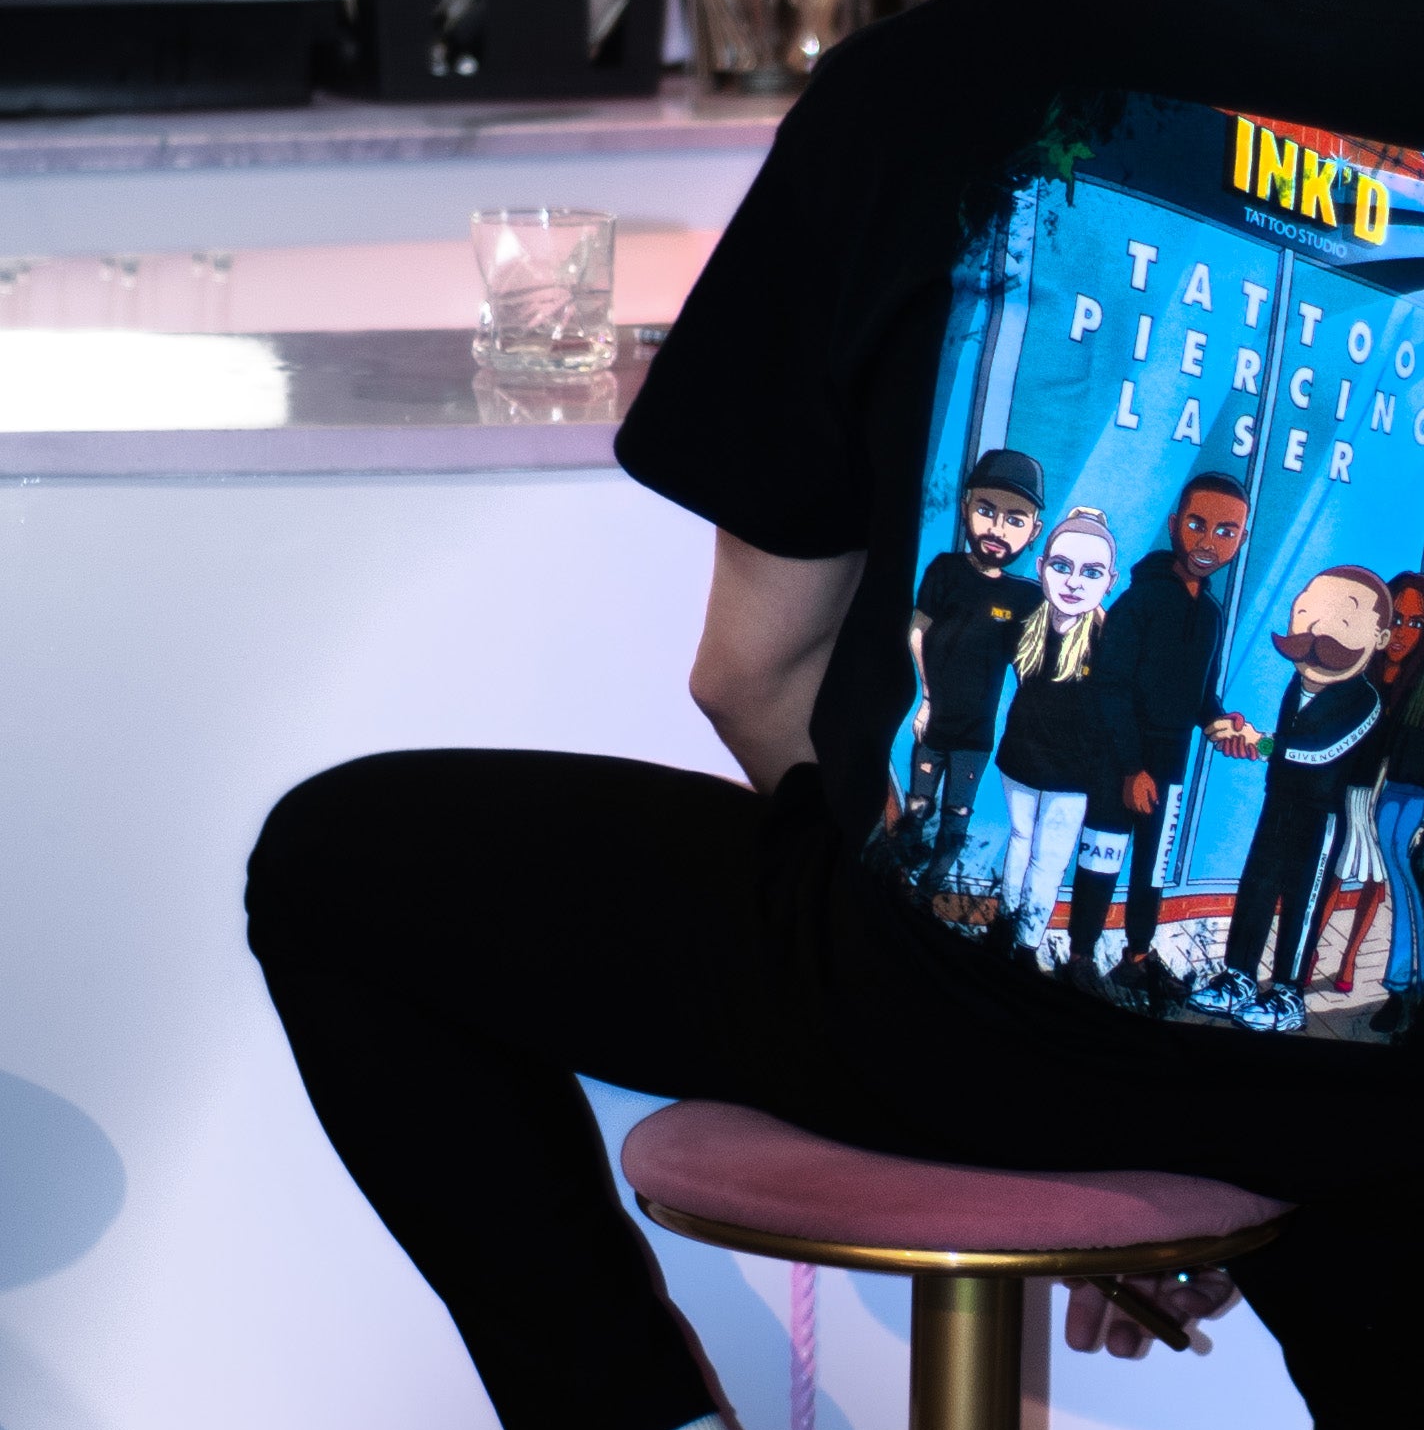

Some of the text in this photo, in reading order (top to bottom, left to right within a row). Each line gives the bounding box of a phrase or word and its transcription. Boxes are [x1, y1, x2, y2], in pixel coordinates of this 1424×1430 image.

[1233, 115, 1390, 246] INK'D
[1244, 206, 1348, 258] TATTOO STUDIO
[1127, 239, 1416, 379] TATTOO
[1115, 379, 1354, 483] LASER
